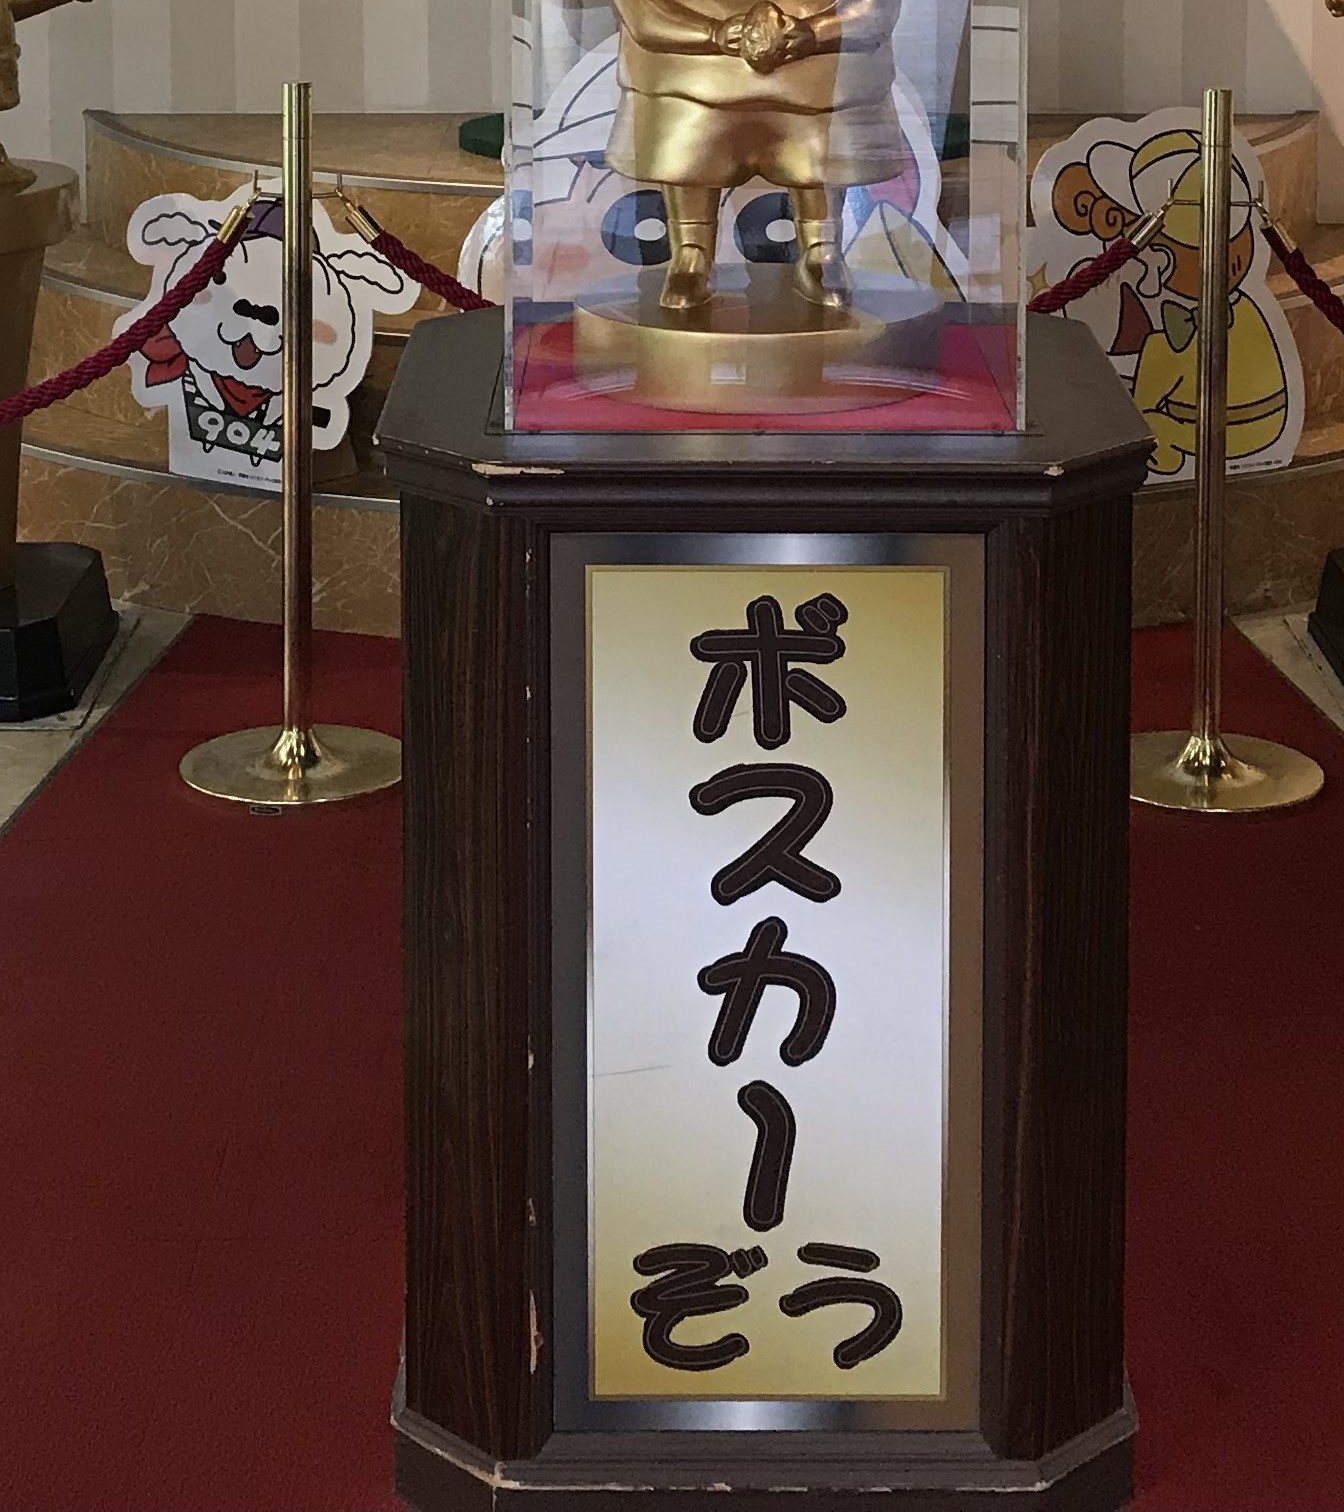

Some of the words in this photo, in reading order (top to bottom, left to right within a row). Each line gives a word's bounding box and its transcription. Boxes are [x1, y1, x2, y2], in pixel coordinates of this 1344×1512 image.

[197, 410, 281, 456] 904
[690, 592, 849, 1233] ボスカー
[630, 1242, 904, 1372] ぞう
